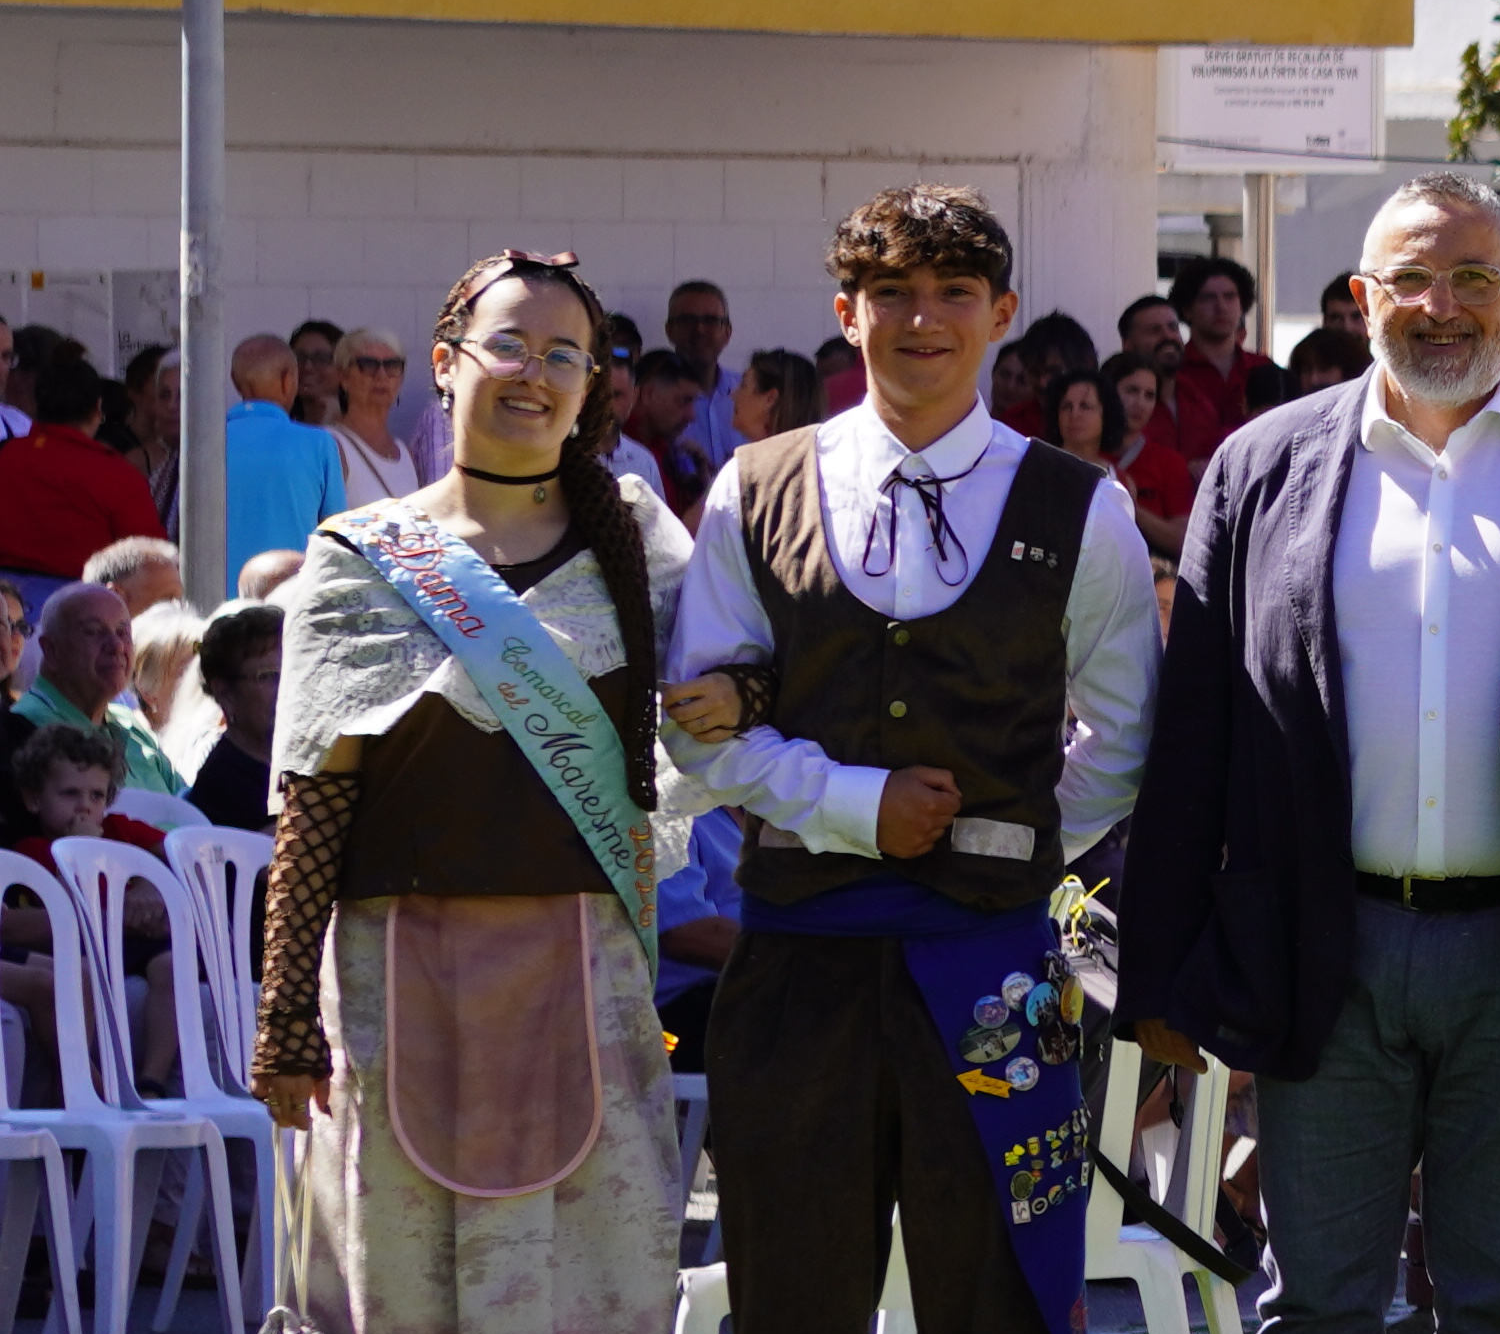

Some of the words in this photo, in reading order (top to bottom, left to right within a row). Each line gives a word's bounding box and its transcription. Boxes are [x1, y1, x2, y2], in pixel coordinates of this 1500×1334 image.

[378, 532, 486, 639] Dama
[497, 682, 530, 710] del
[524, 714, 630, 870] Maresme
